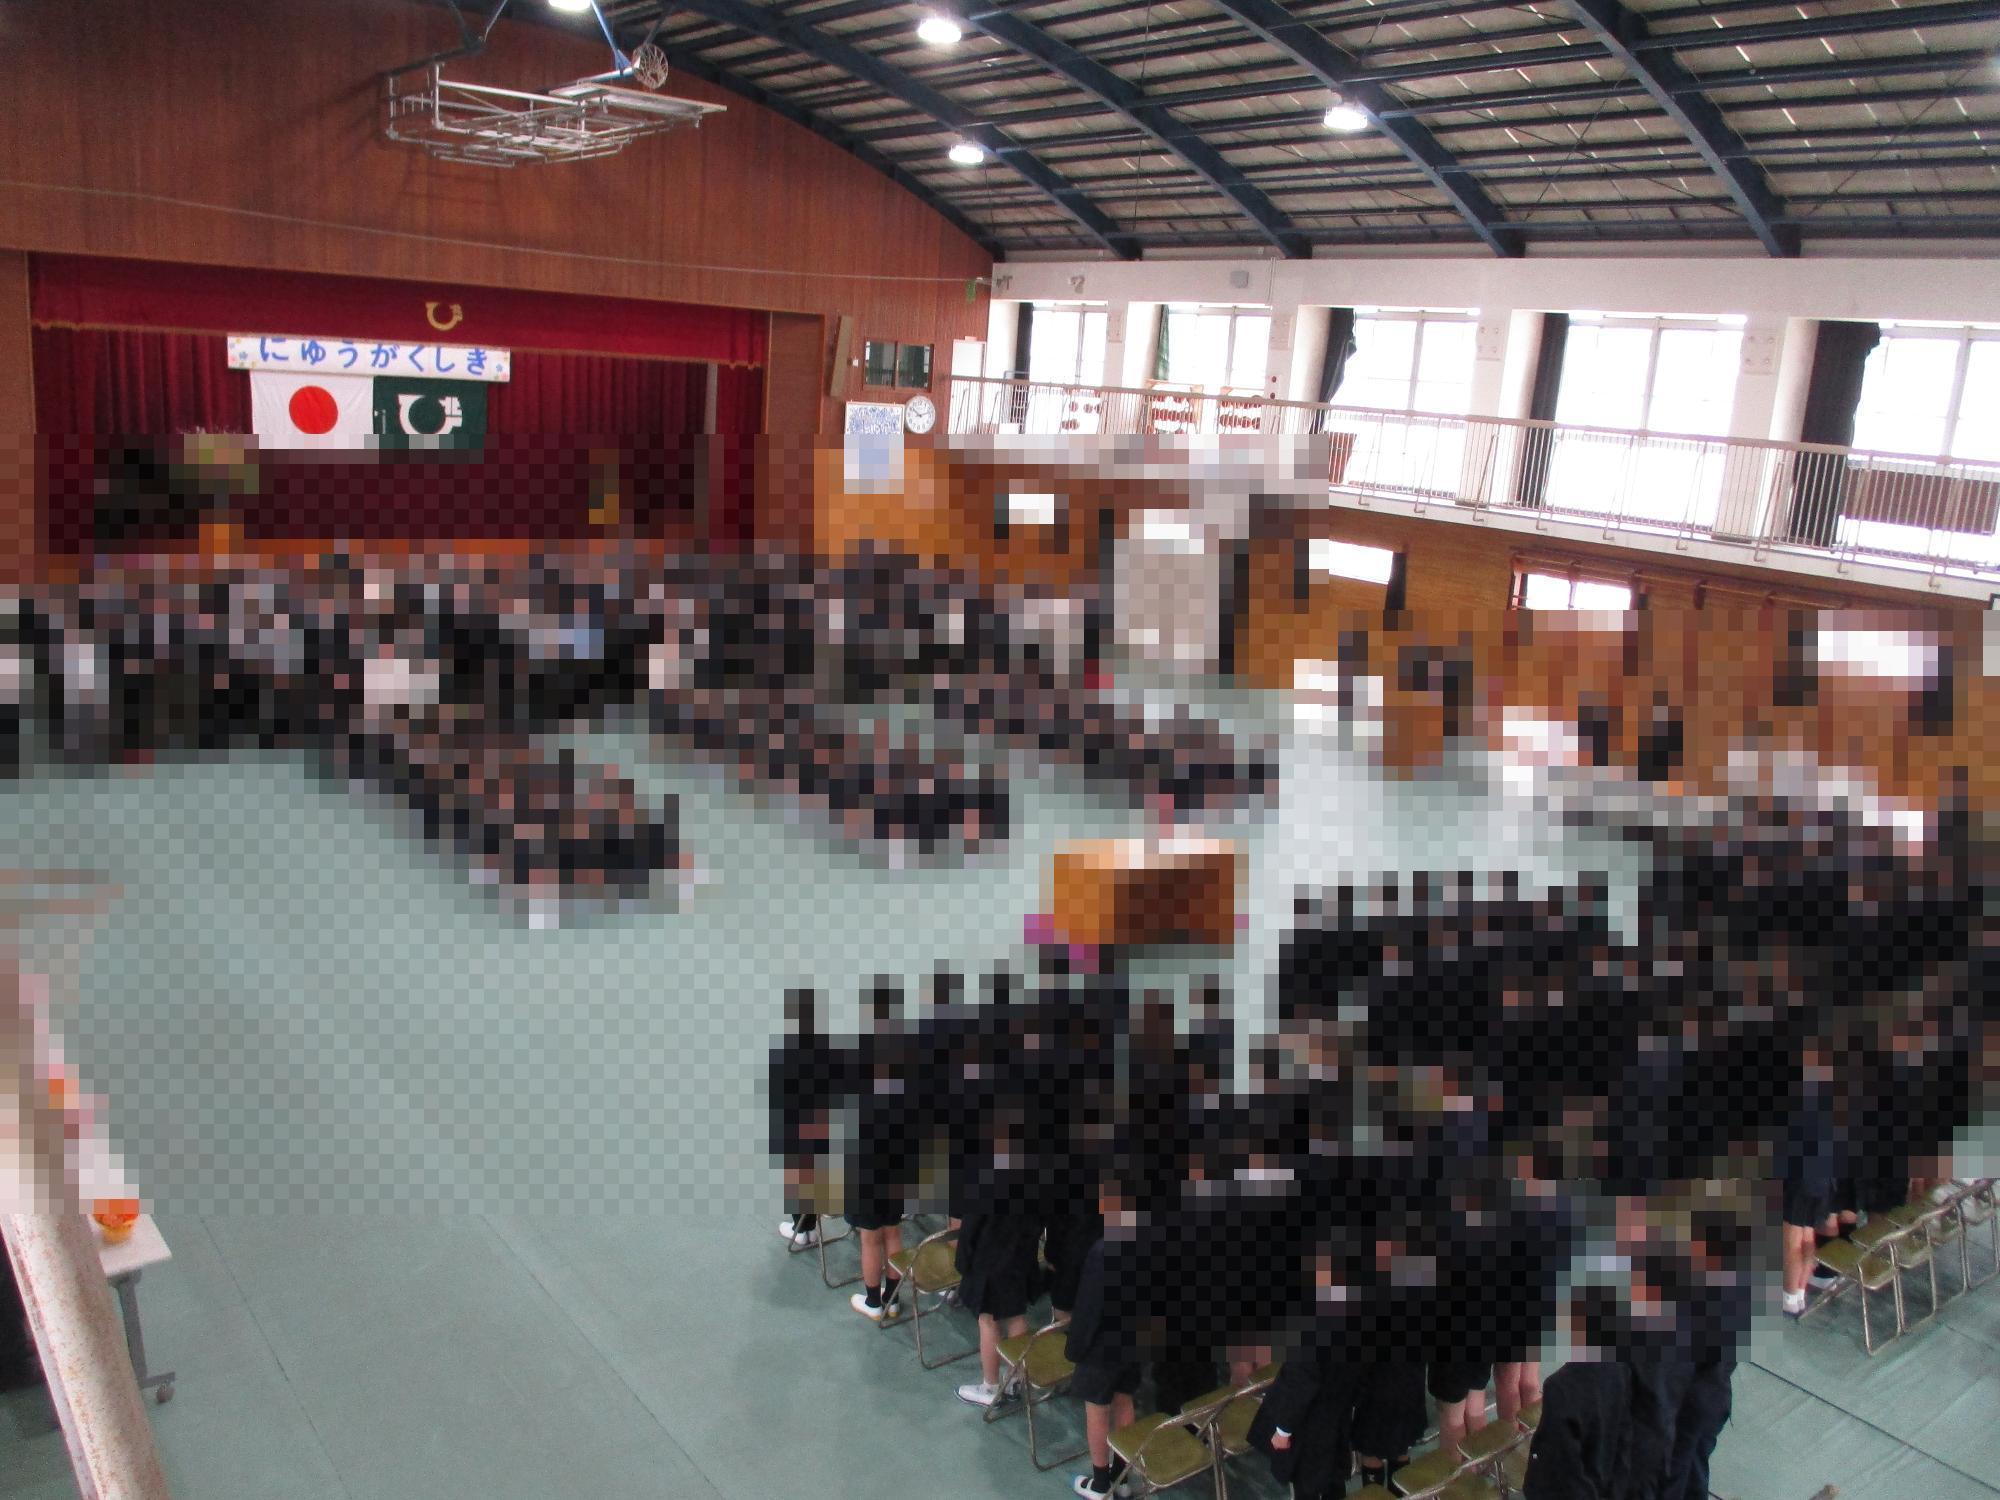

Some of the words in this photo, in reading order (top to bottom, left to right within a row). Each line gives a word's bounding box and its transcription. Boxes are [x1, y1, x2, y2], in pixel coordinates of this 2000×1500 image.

[259, 336, 488, 375] にゅうがくしき
